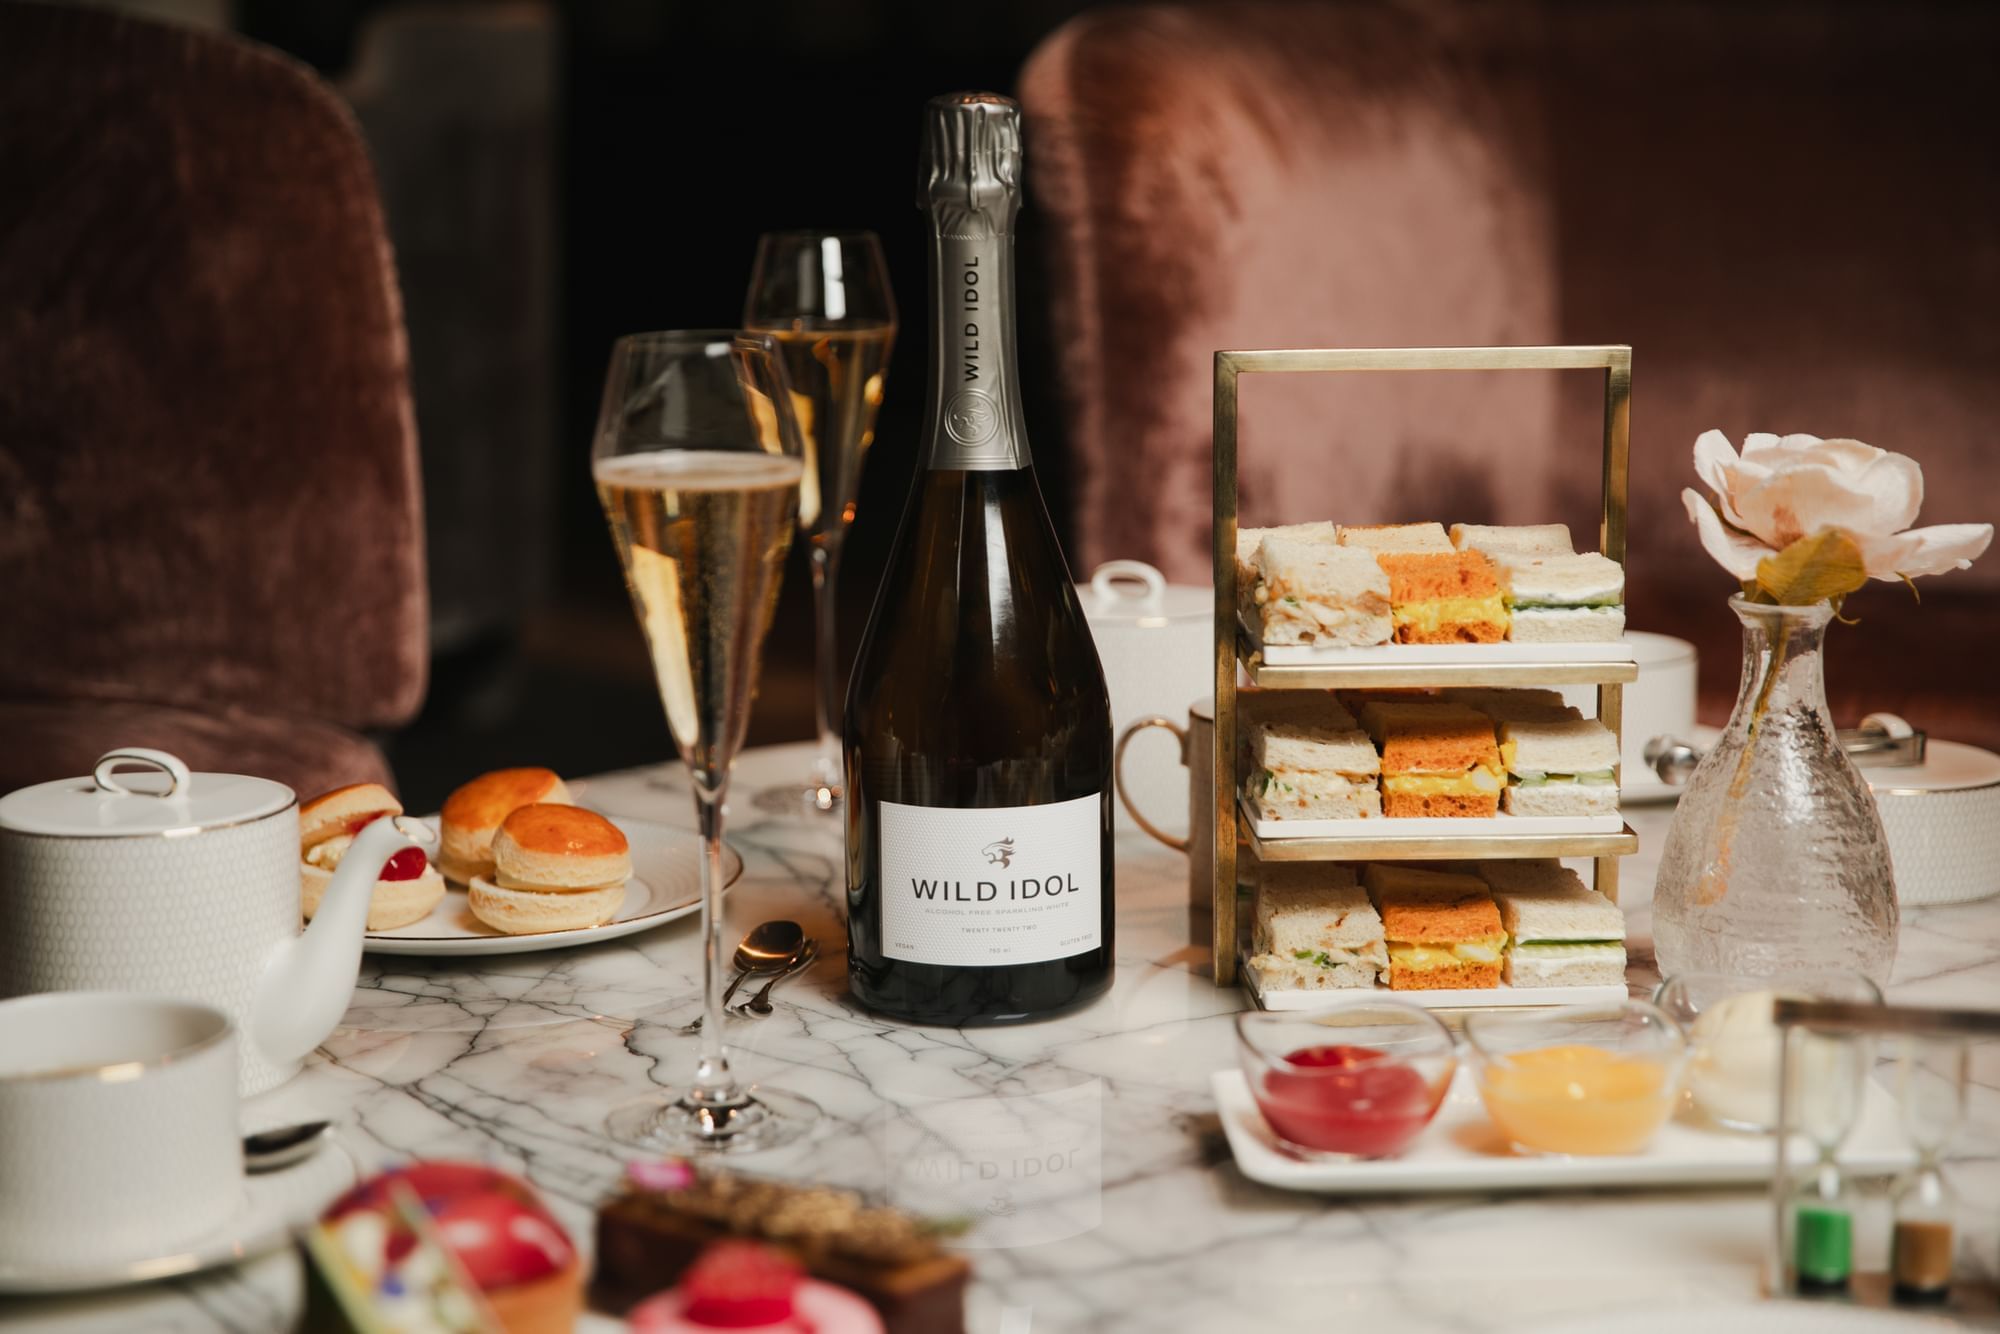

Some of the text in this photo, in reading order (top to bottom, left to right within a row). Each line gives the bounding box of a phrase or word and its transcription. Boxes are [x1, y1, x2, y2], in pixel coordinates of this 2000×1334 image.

[964, 256, 979, 382] WILD IDOL
[911, 873, 1079, 901] WILD IDOL
[925, 908, 966, 916] ALCOHOL
[995, 905, 1044, 915] SPARKLING
[1046, 901, 1070, 911] WHITE
[895, 942, 914, 950] VEGAN
